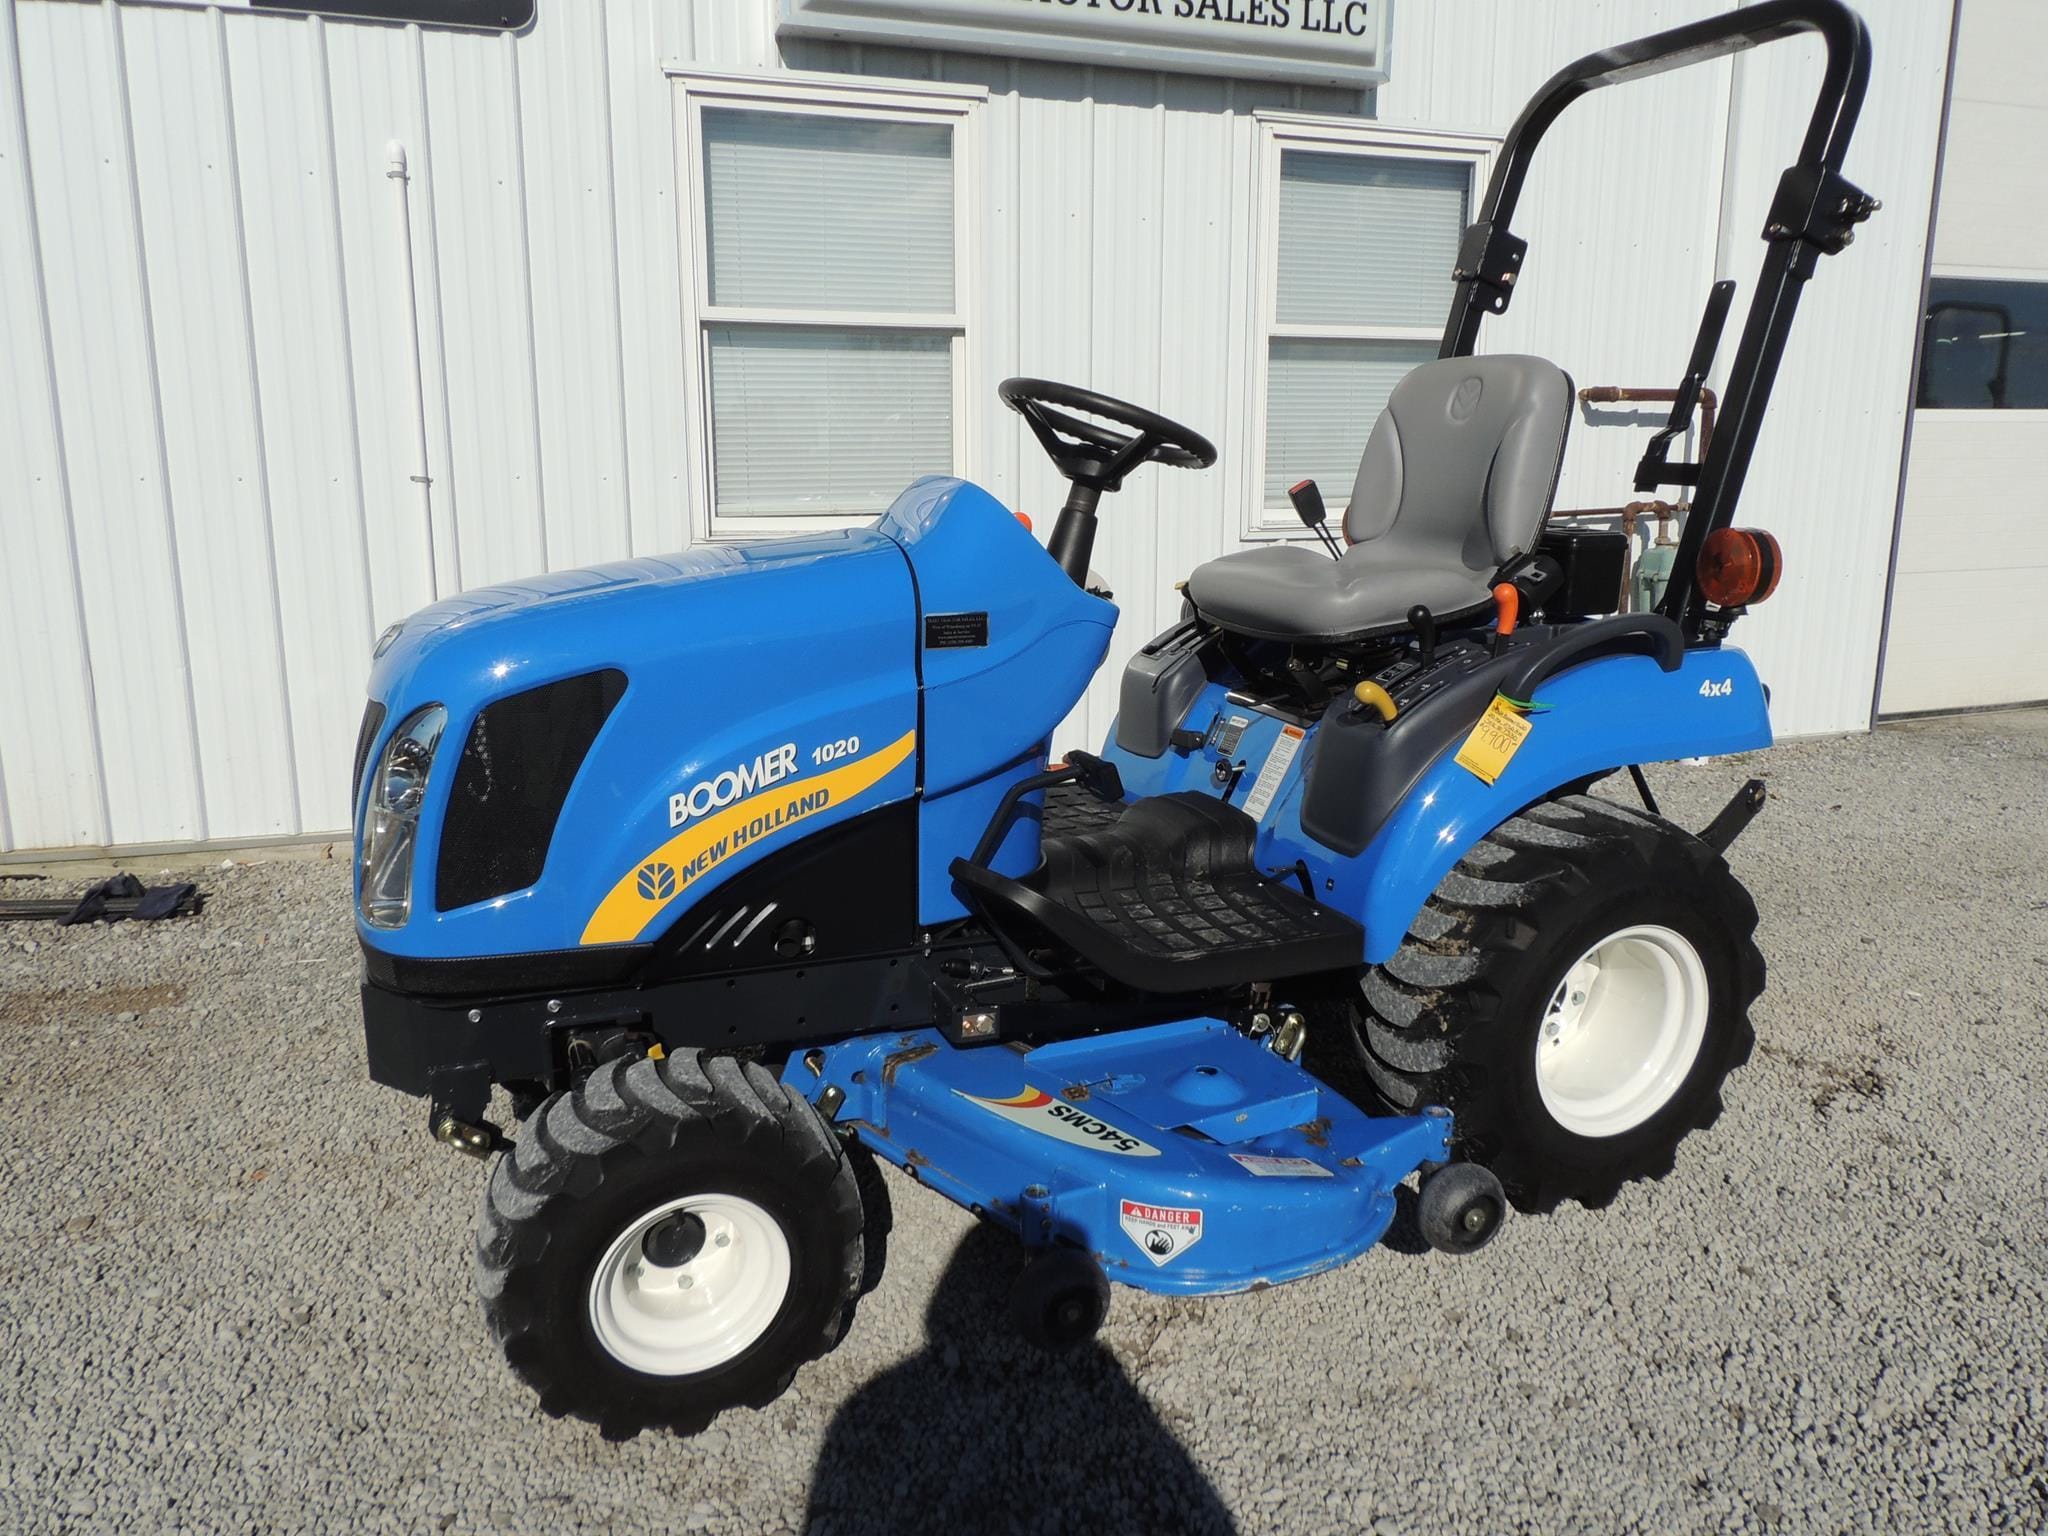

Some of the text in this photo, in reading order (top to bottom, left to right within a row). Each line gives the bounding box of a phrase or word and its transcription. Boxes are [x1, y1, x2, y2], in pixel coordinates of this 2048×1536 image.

[1174, 0, 1290, 28] SALES
[1300, 0, 1367, 37] LLC
[1699, 678, 1732, 697] 4x4
[669, 735, 861, 829] BOOMER 1020
[682, 788, 830, 885] NEW HOLLAND
[1047, 1105, 1140, 1152] 54CMS
[1144, 1207, 1191, 1223] DANGER
